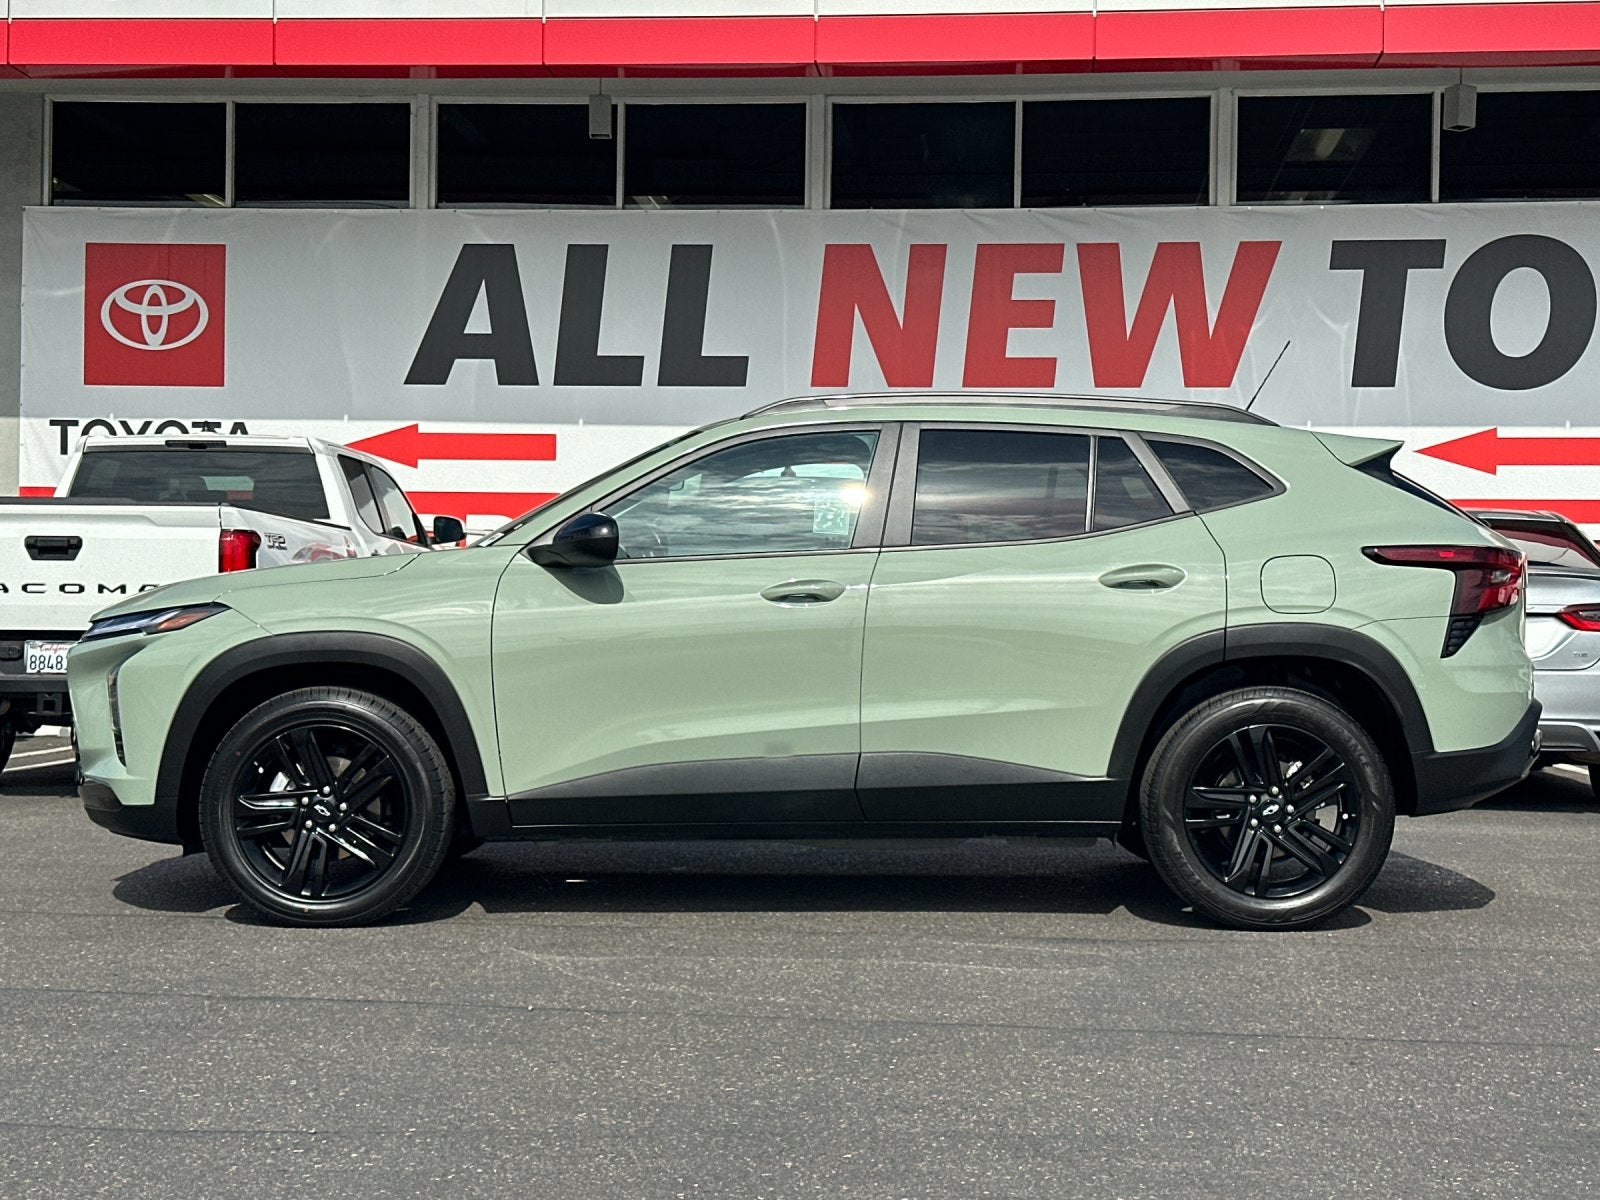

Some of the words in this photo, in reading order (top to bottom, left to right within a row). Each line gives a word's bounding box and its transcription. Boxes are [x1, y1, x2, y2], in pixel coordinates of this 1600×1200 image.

[404, 243, 749, 387] ALL
[811, 241, 1281, 388] NEW
[1329, 233, 1598, 391] TO
[29, 654, 67, 671] 8848
